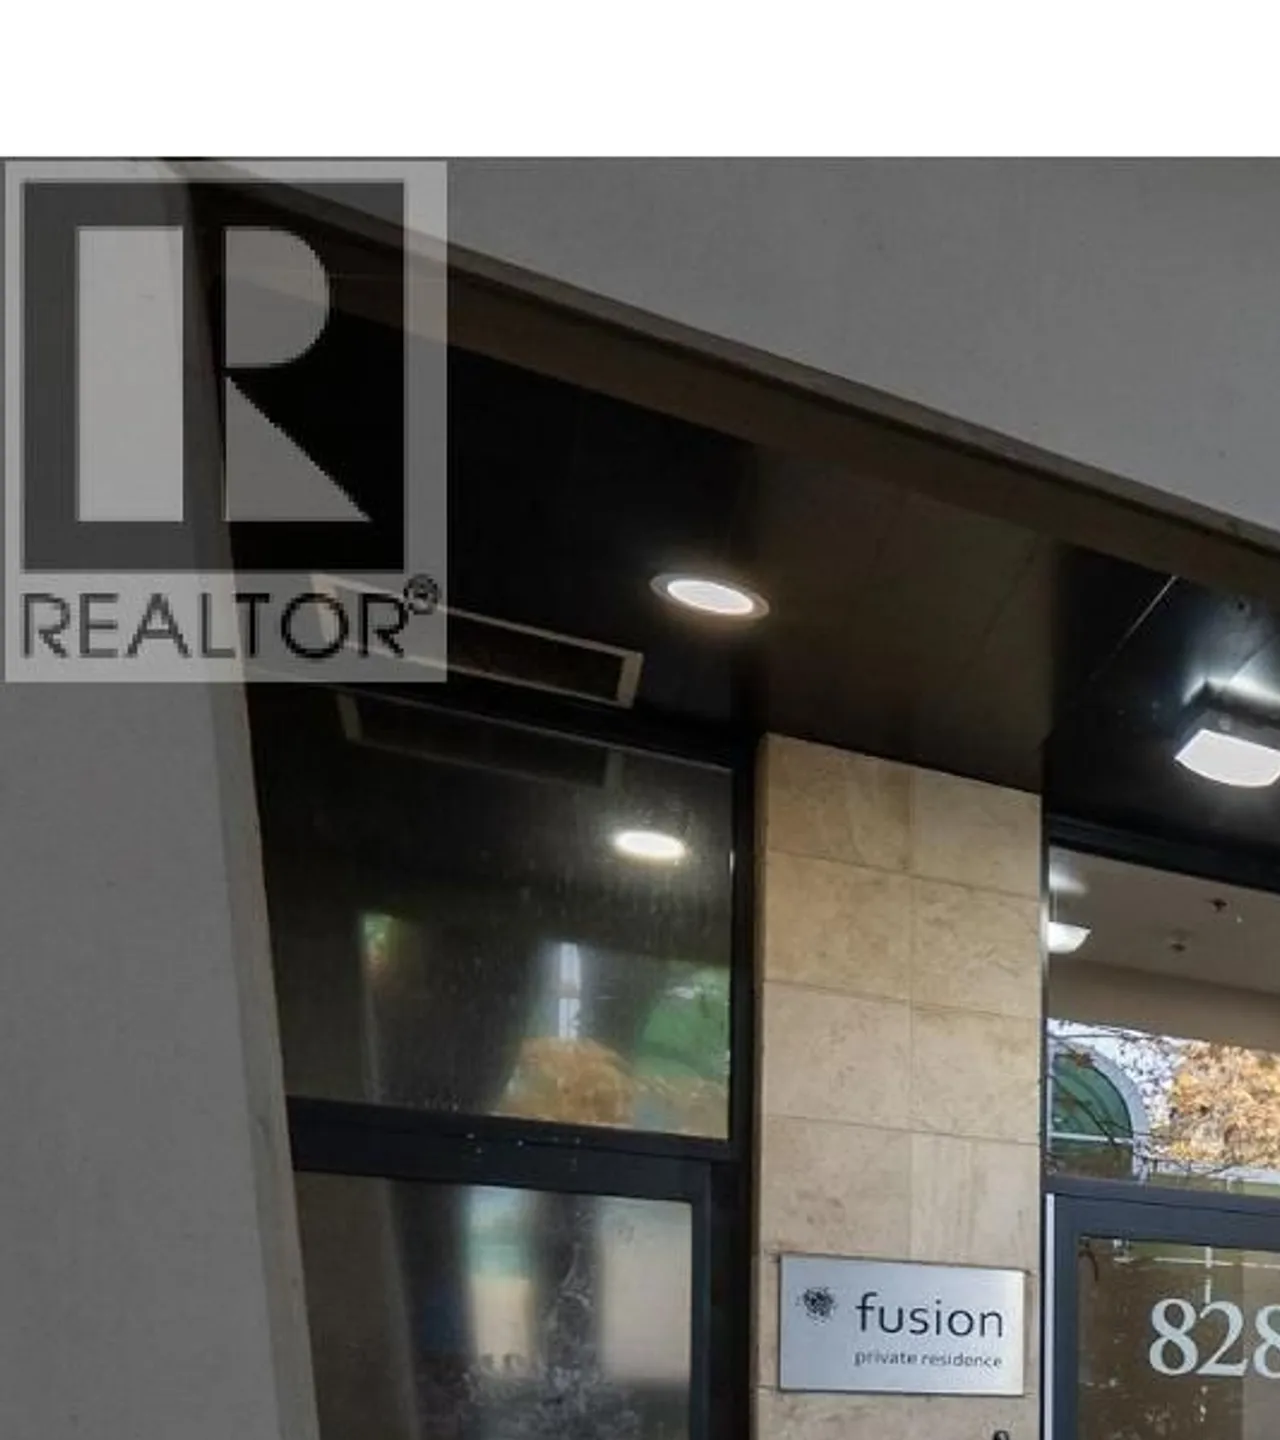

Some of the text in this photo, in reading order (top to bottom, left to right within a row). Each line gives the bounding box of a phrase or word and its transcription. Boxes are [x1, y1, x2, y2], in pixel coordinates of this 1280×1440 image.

[855, 1291, 1004, 1338] fusion
[854, 1350, 1002, 1369] private residence
